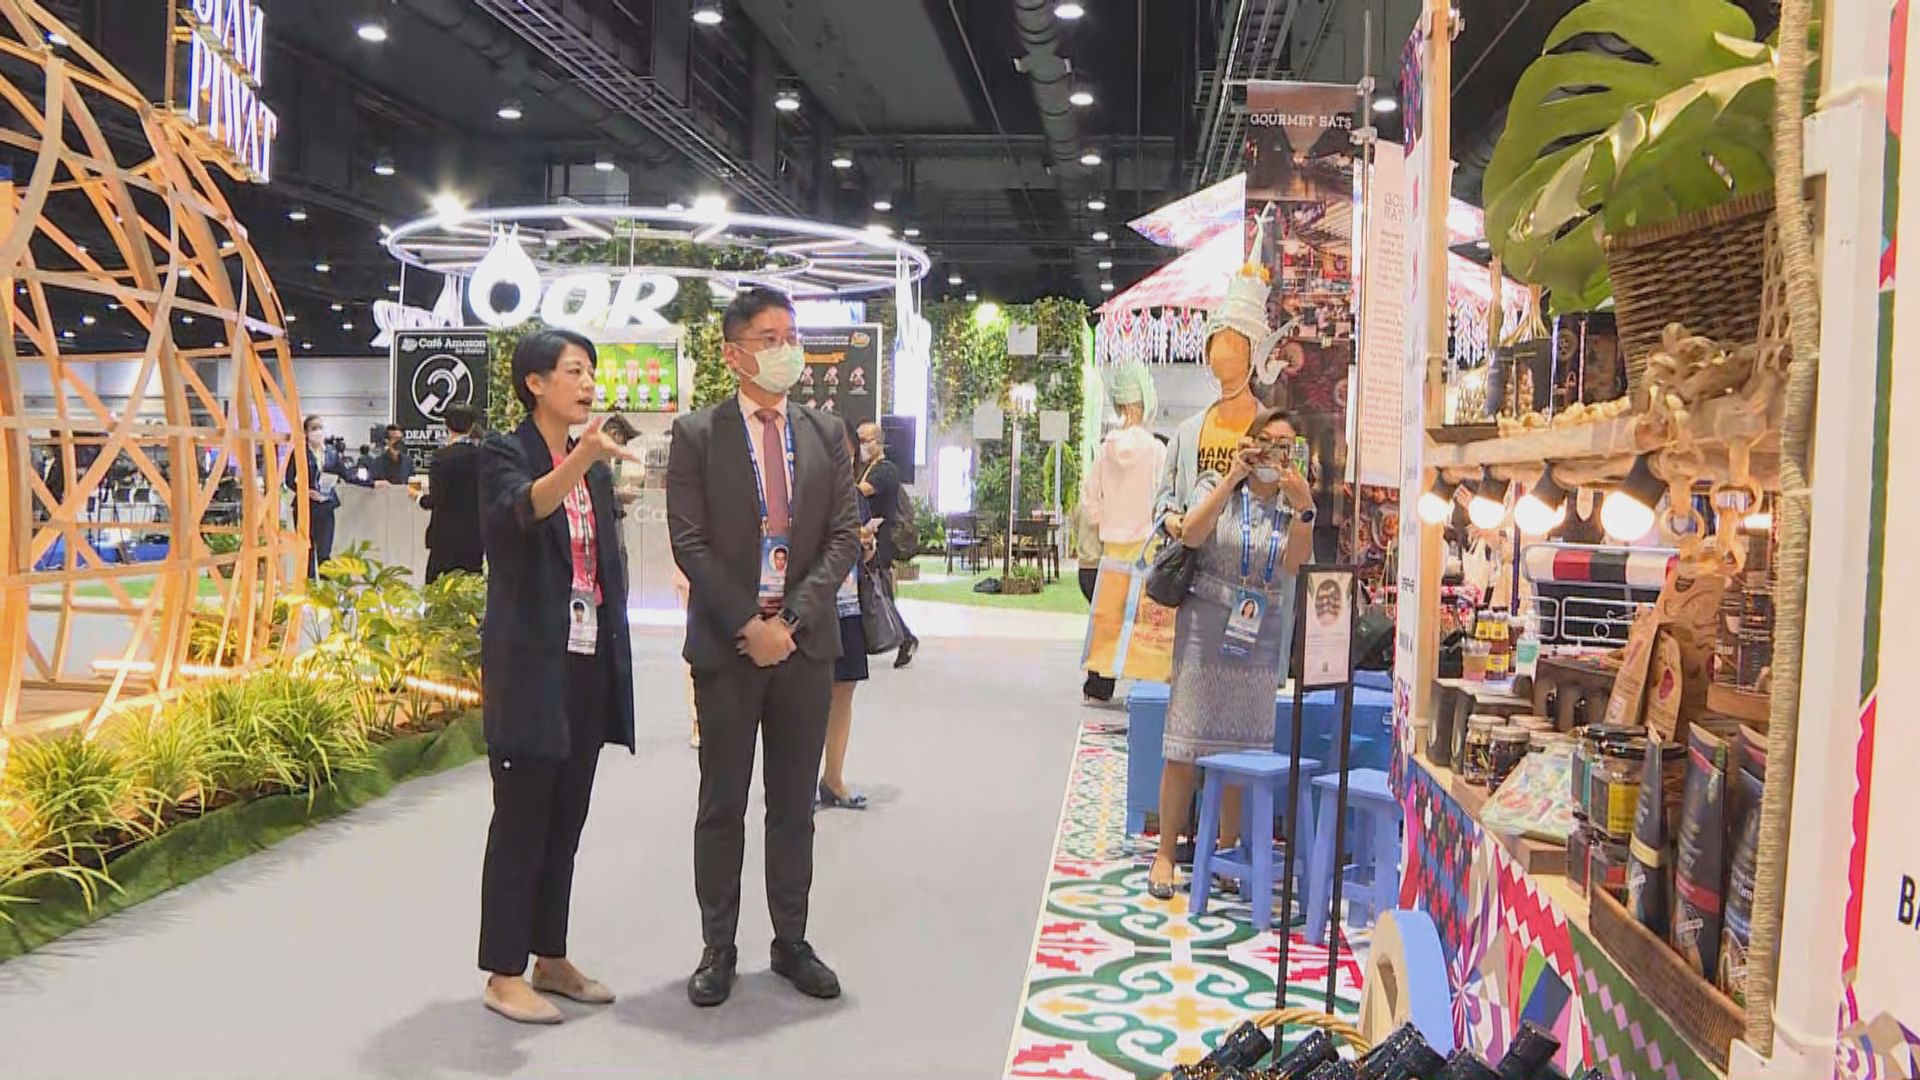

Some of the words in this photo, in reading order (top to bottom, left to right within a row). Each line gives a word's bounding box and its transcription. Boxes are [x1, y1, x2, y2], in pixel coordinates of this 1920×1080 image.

[1250, 113, 1315, 128] GOURMET
[1319, 115, 1352, 129] EATS
[418, 337, 443, 349] Café
[444, 338, 486, 349] Amazon
[405, 429, 431, 440] DEAF
